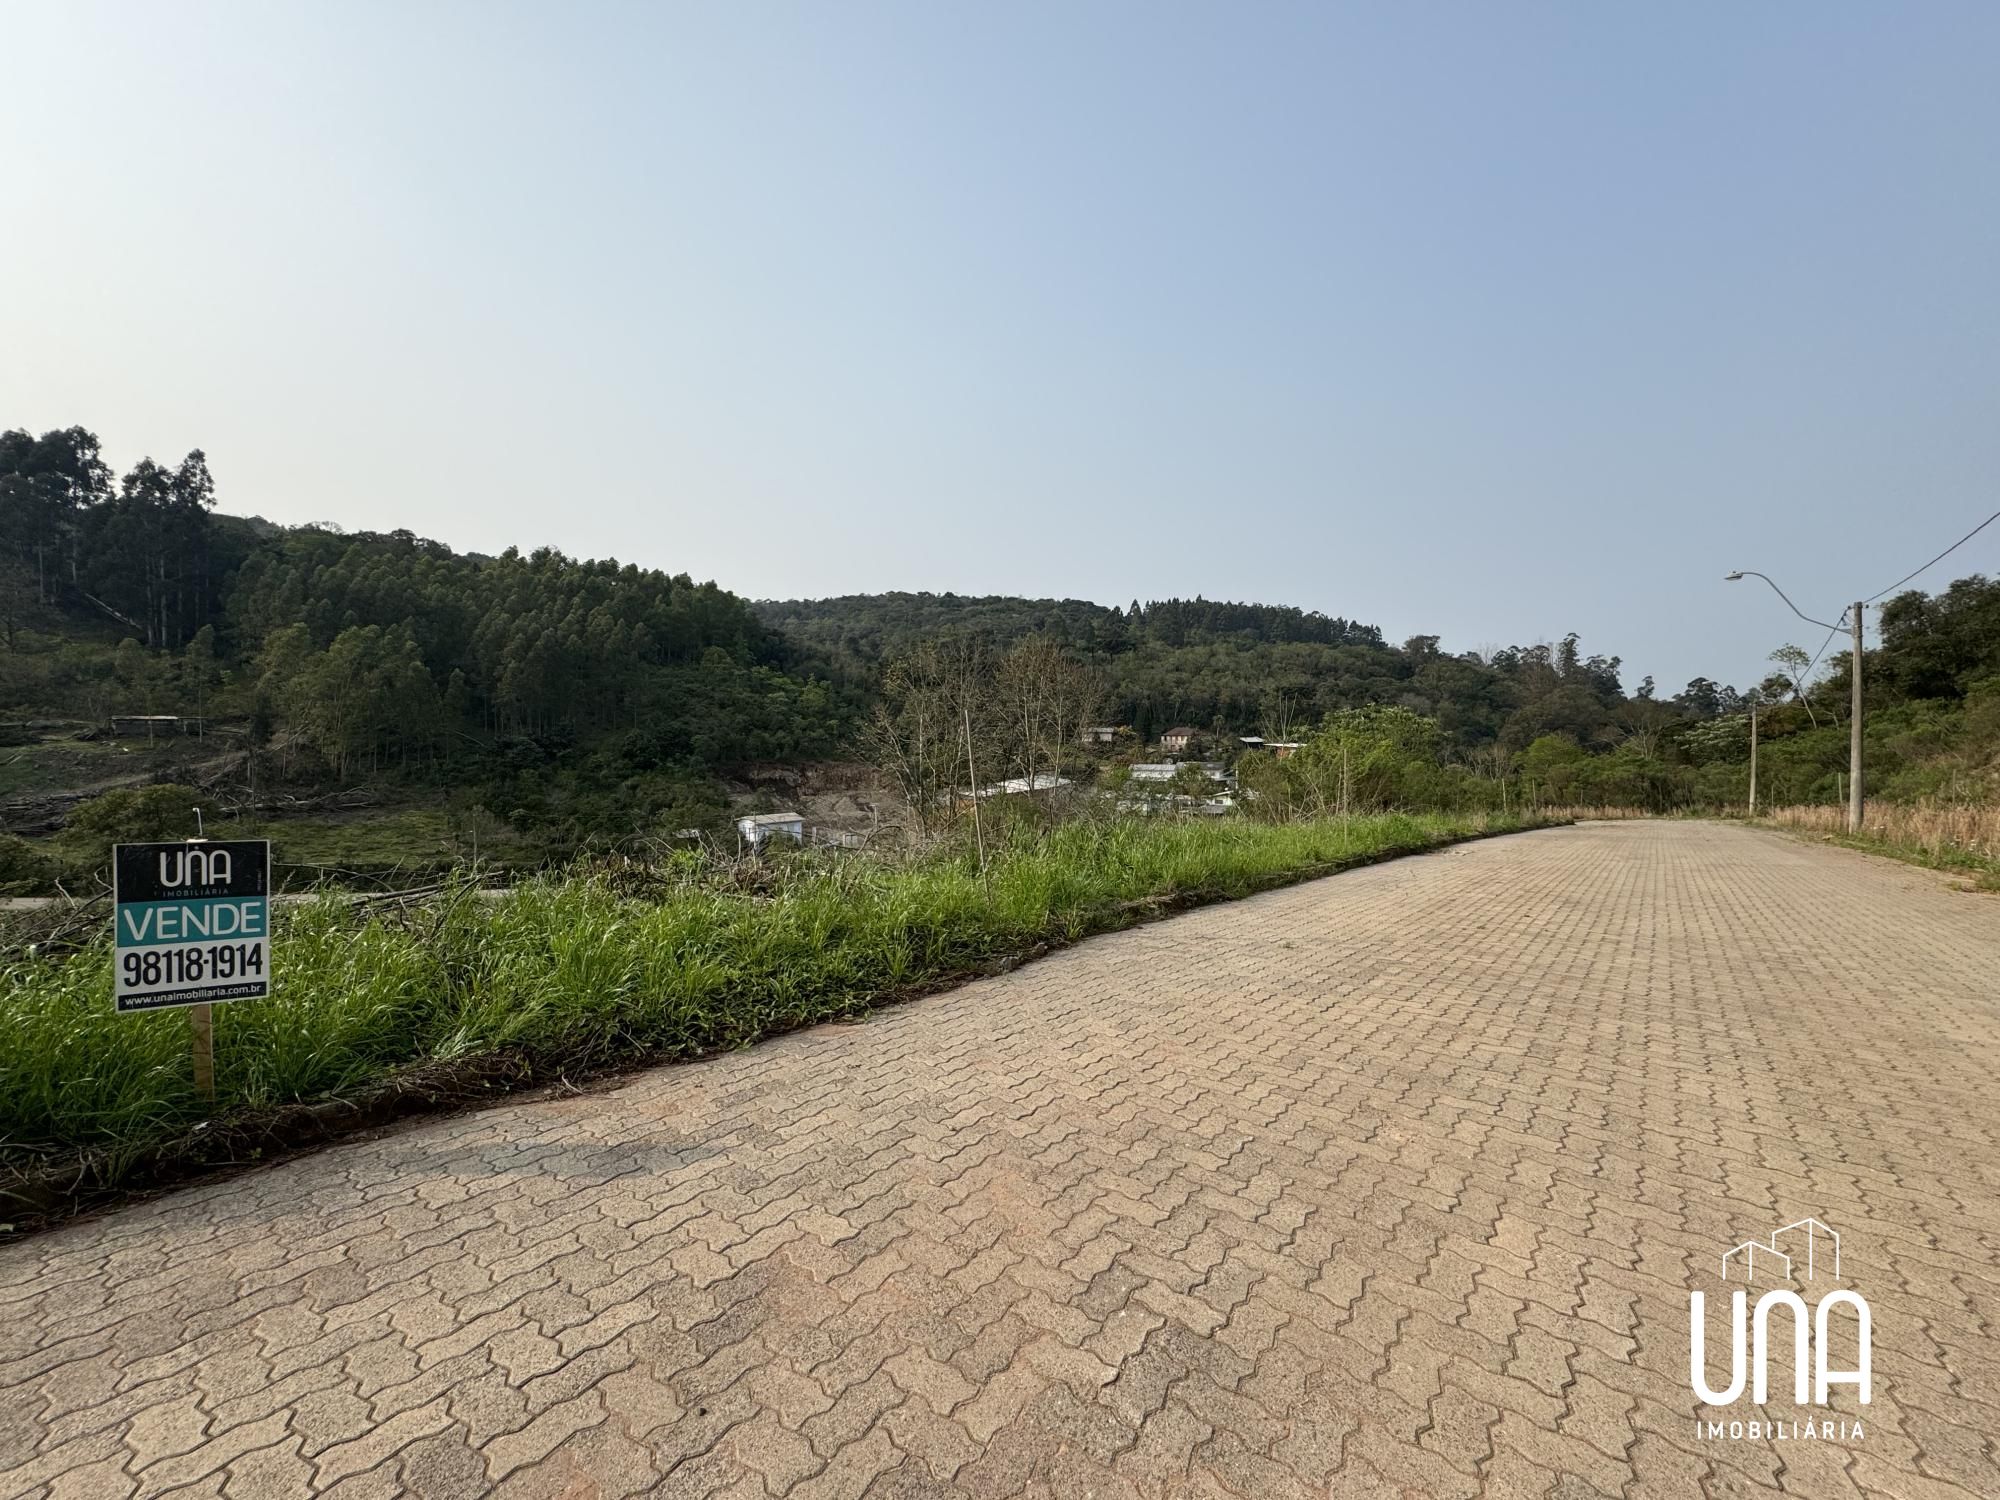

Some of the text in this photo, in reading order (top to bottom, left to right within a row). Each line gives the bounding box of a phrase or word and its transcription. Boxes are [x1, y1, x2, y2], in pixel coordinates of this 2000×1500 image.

[160, 850, 231, 887] UNA
[123, 902, 261, 941] VENDE
[123, 943, 263, 987] 98118-1914
[124, 985, 261, 1006] www.unaimobiliaria.com.br
